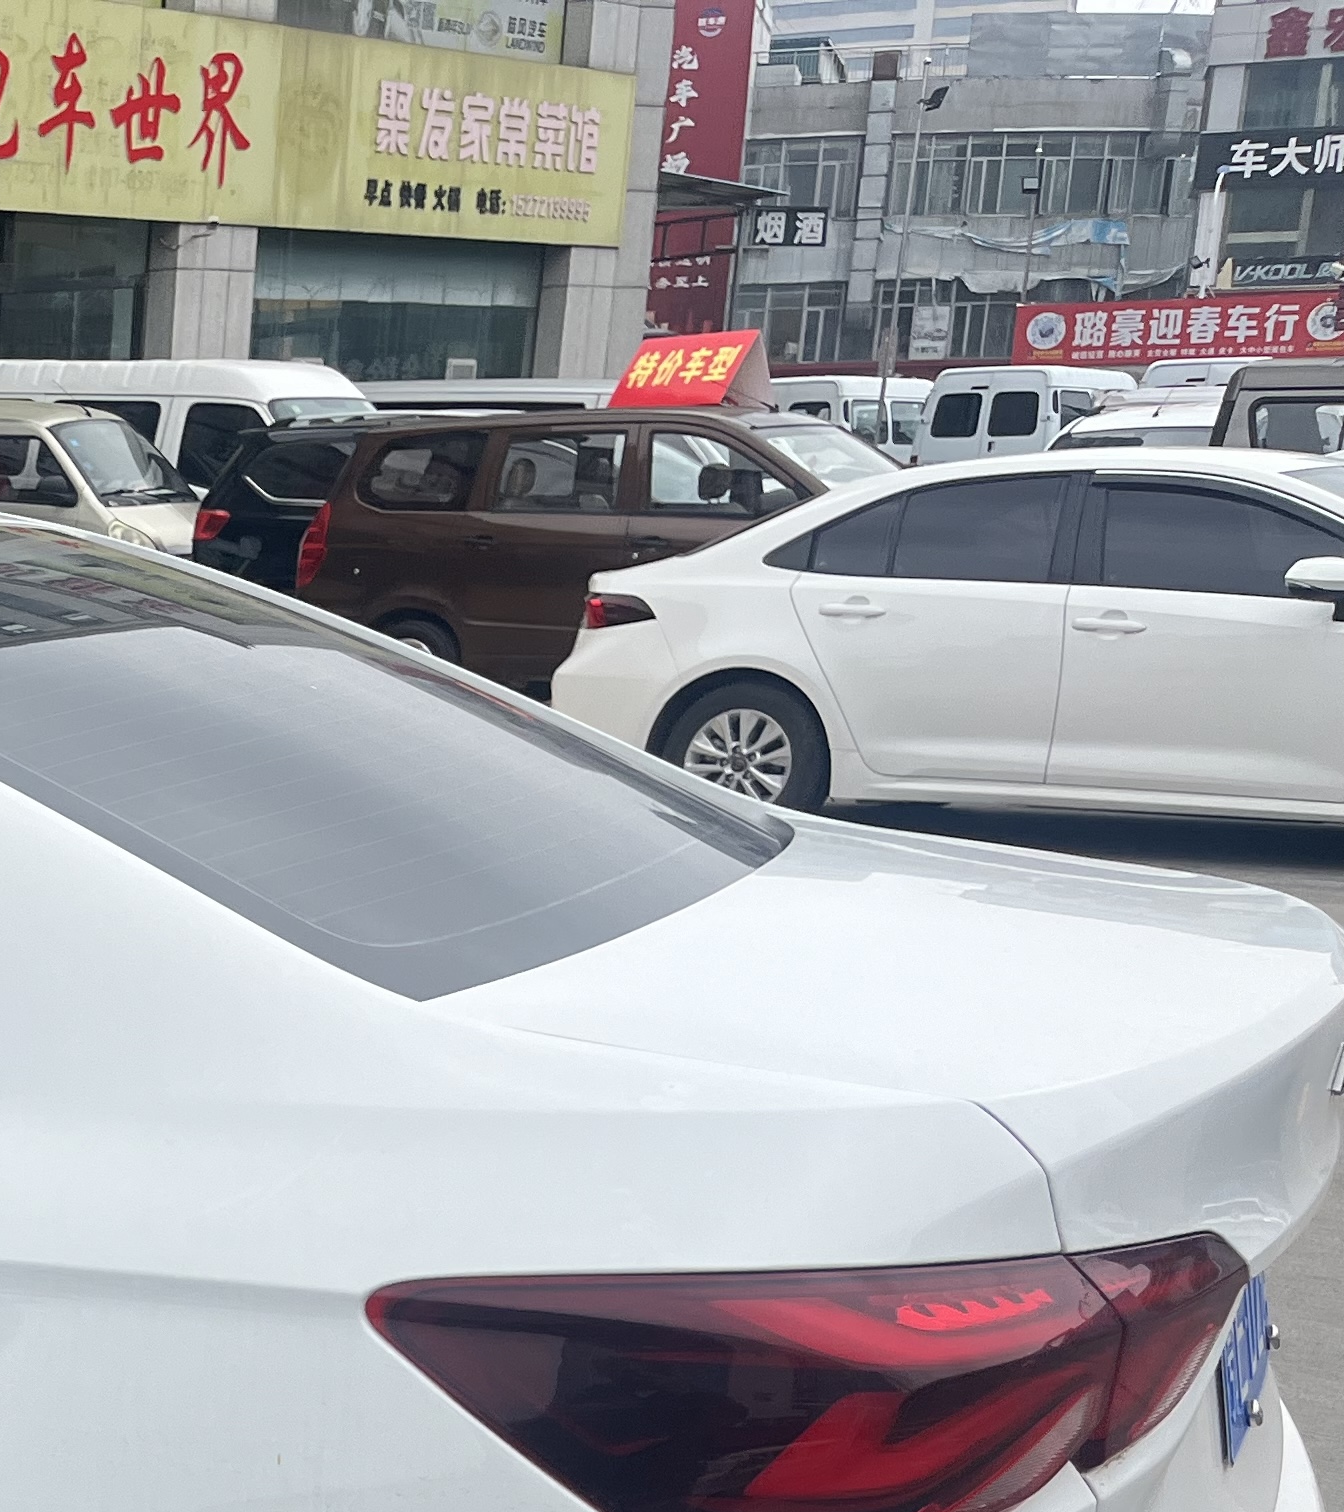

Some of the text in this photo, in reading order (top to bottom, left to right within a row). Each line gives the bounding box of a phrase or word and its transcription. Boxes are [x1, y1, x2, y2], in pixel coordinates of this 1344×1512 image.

[375, 80, 600, 173] 聚发家常菜馆
[755, 210, 825, 245] 烟酒
[1233, 263, 1314, 284] V-KOOL
[626, 343, 743, 389] 特价车型
